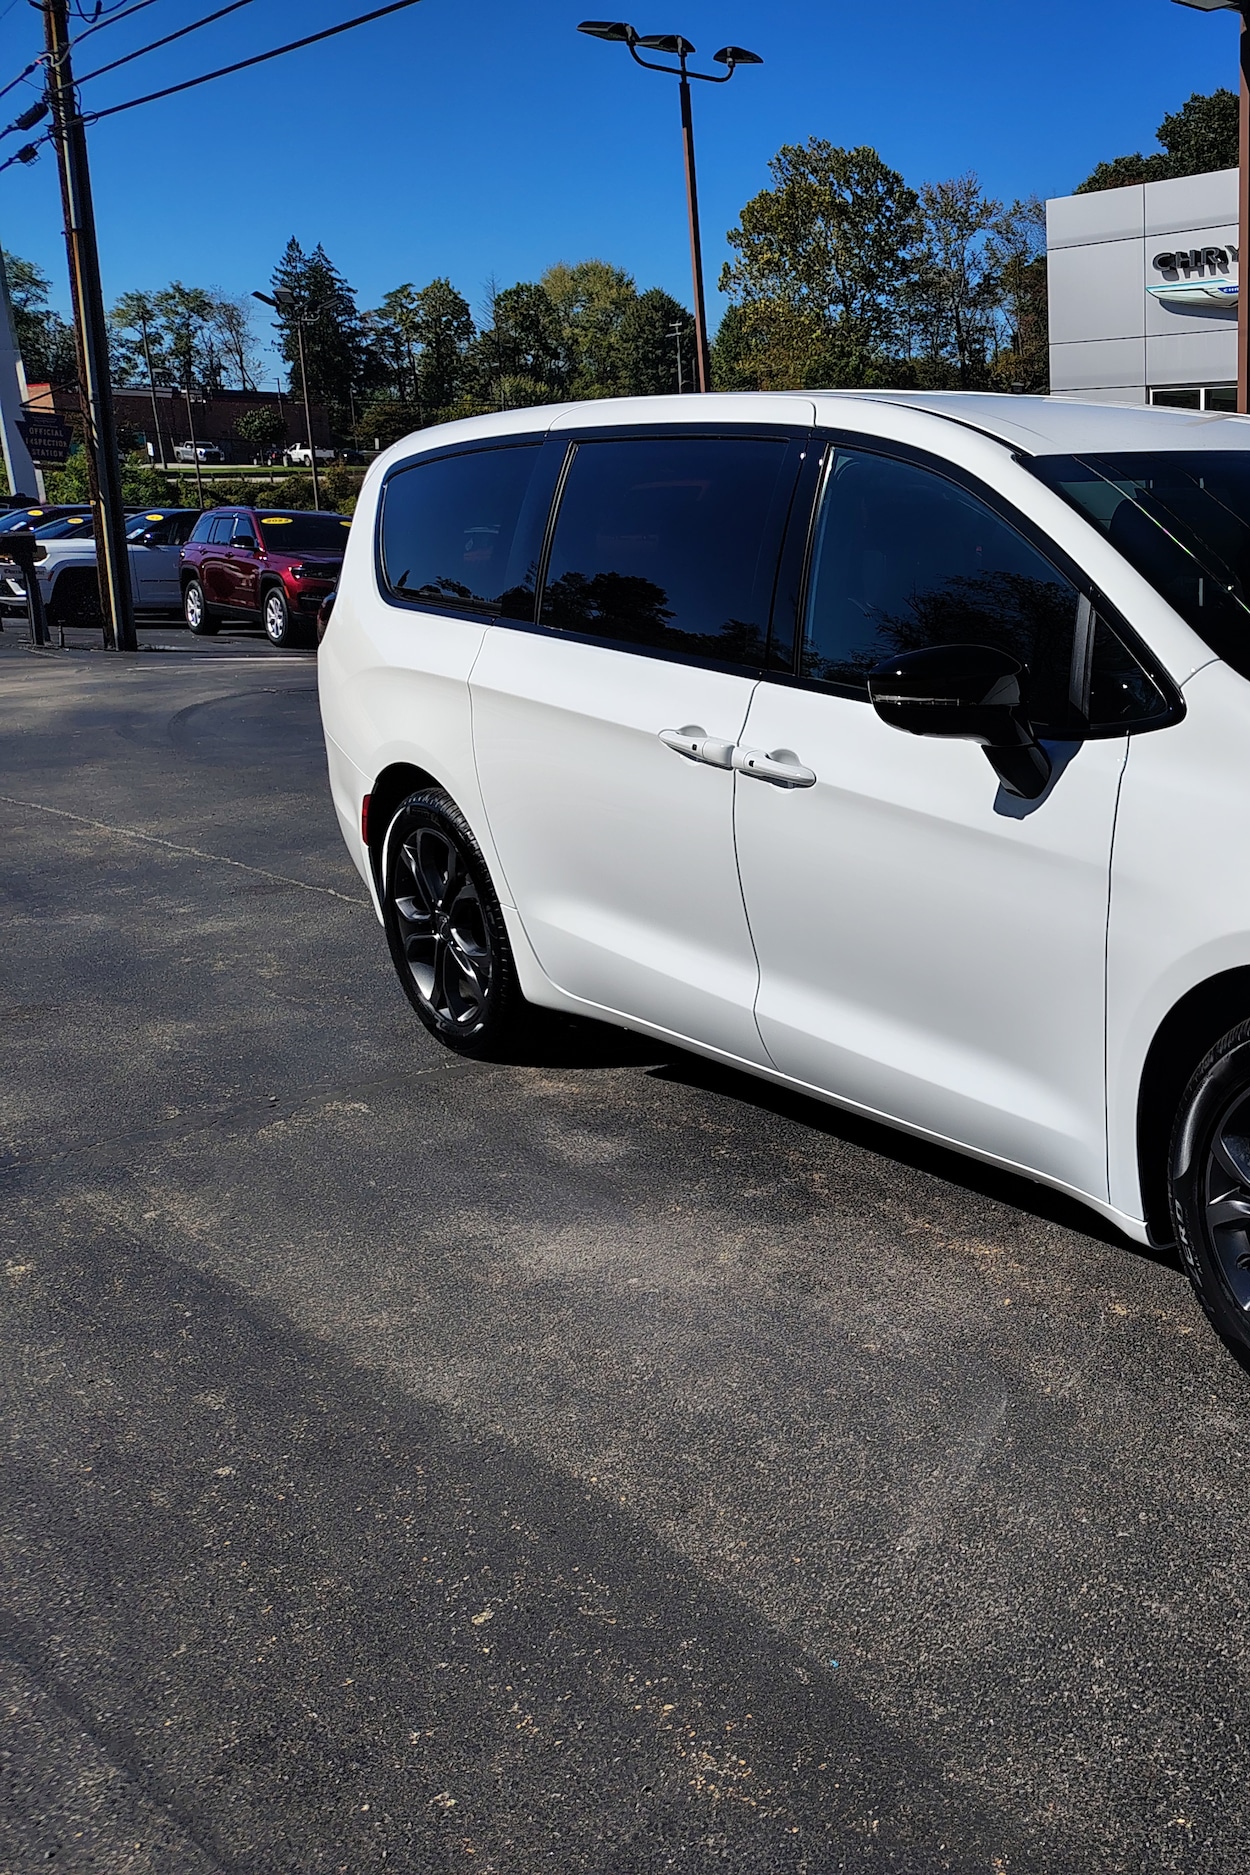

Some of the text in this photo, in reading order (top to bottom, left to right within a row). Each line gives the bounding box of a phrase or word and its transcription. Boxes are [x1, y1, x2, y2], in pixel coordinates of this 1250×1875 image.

[28, 427, 64, 438] OFFICIAL
[25, 437, 68, 448] INSPECTION
[31, 448, 64, 458] STATION
